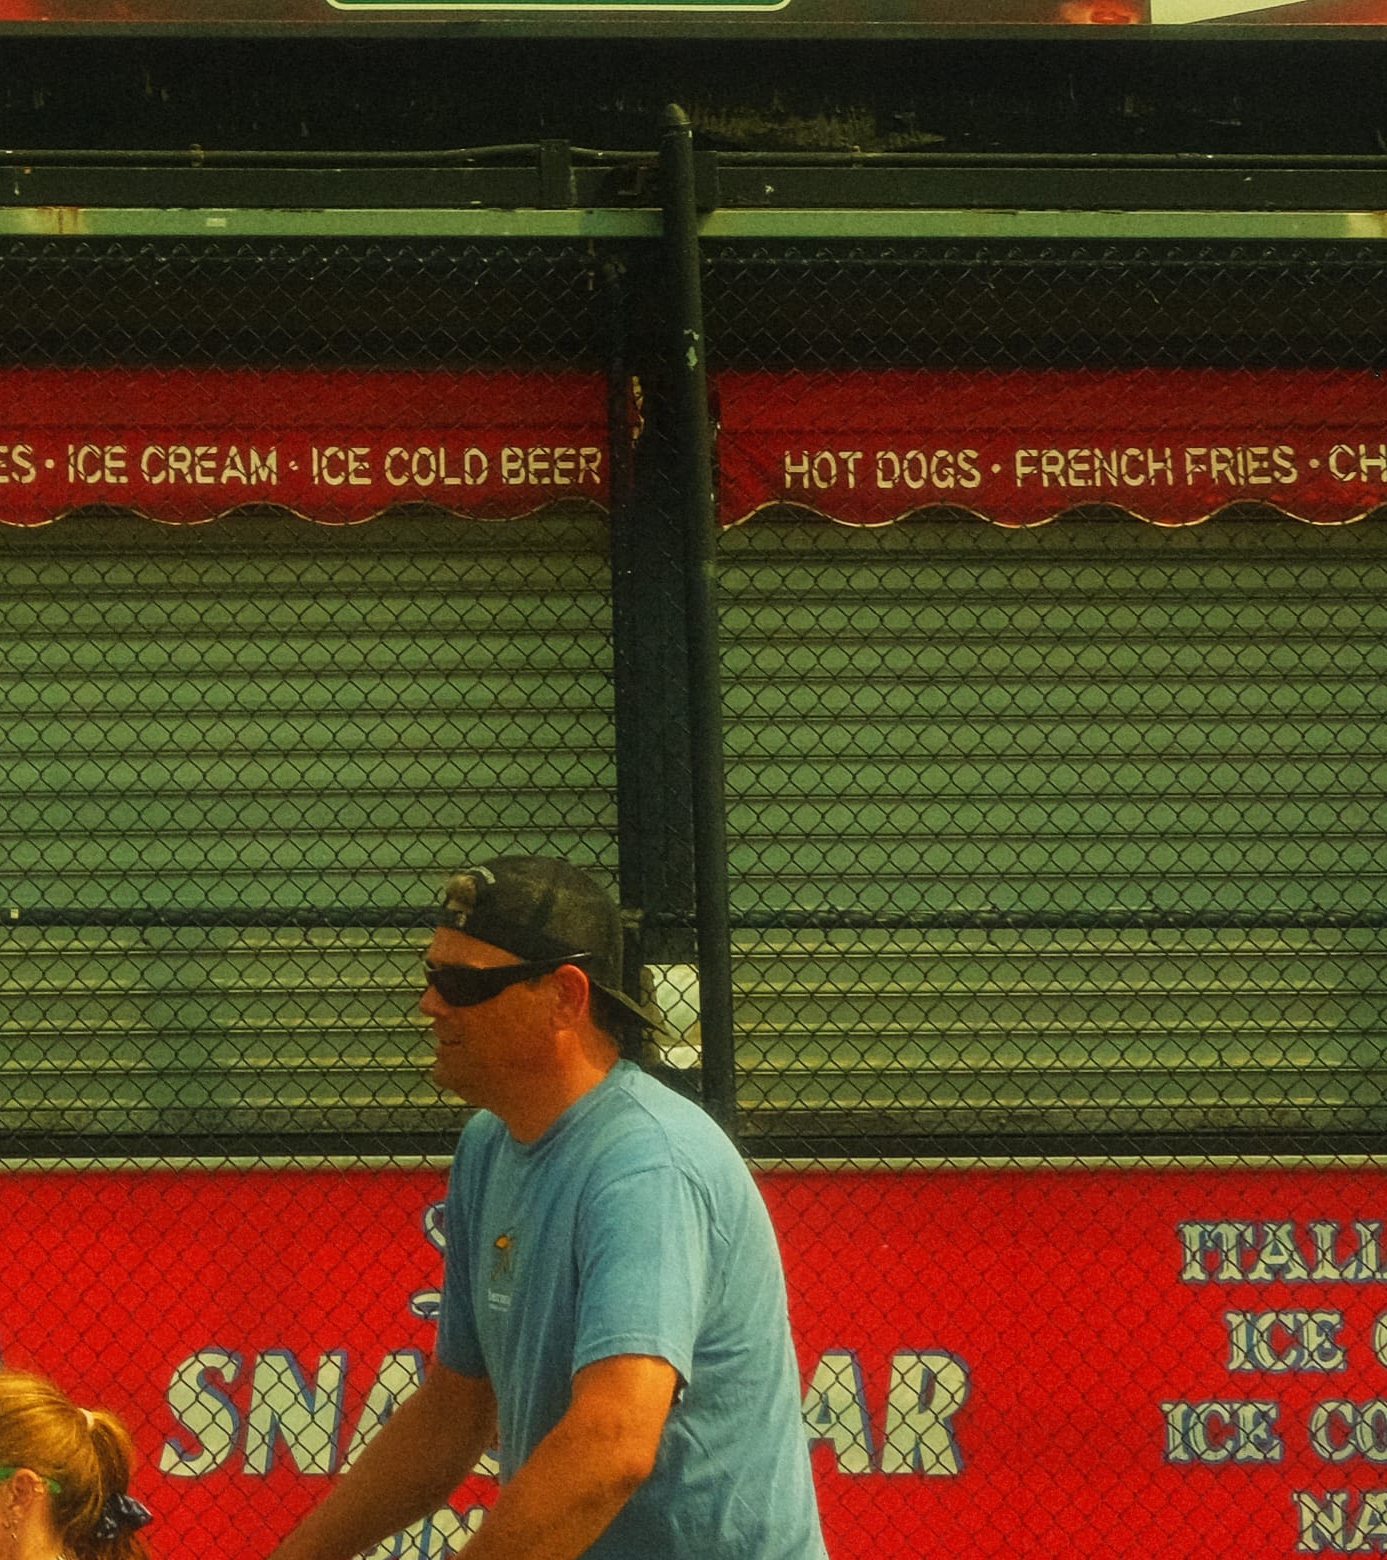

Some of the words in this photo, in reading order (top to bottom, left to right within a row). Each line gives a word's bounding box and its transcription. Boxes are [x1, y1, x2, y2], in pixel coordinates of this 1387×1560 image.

[67, 443, 129, 484] ICE
[140, 443, 278, 485] CREAM
[311, 445, 372, 486] ICE
[384, 446, 489, 486] COLD
[500, 446, 602, 485] BEER
[783, 449, 863, 490] HOT
[875, 449, 982, 489] DOGS
[1013, 447, 1173, 489] FRENCH
[1185, 445, 1299, 486] FRIES
[1224, 1310, 1347, 1373] ICE
[1160, 1399, 1284, 1464] ICE
